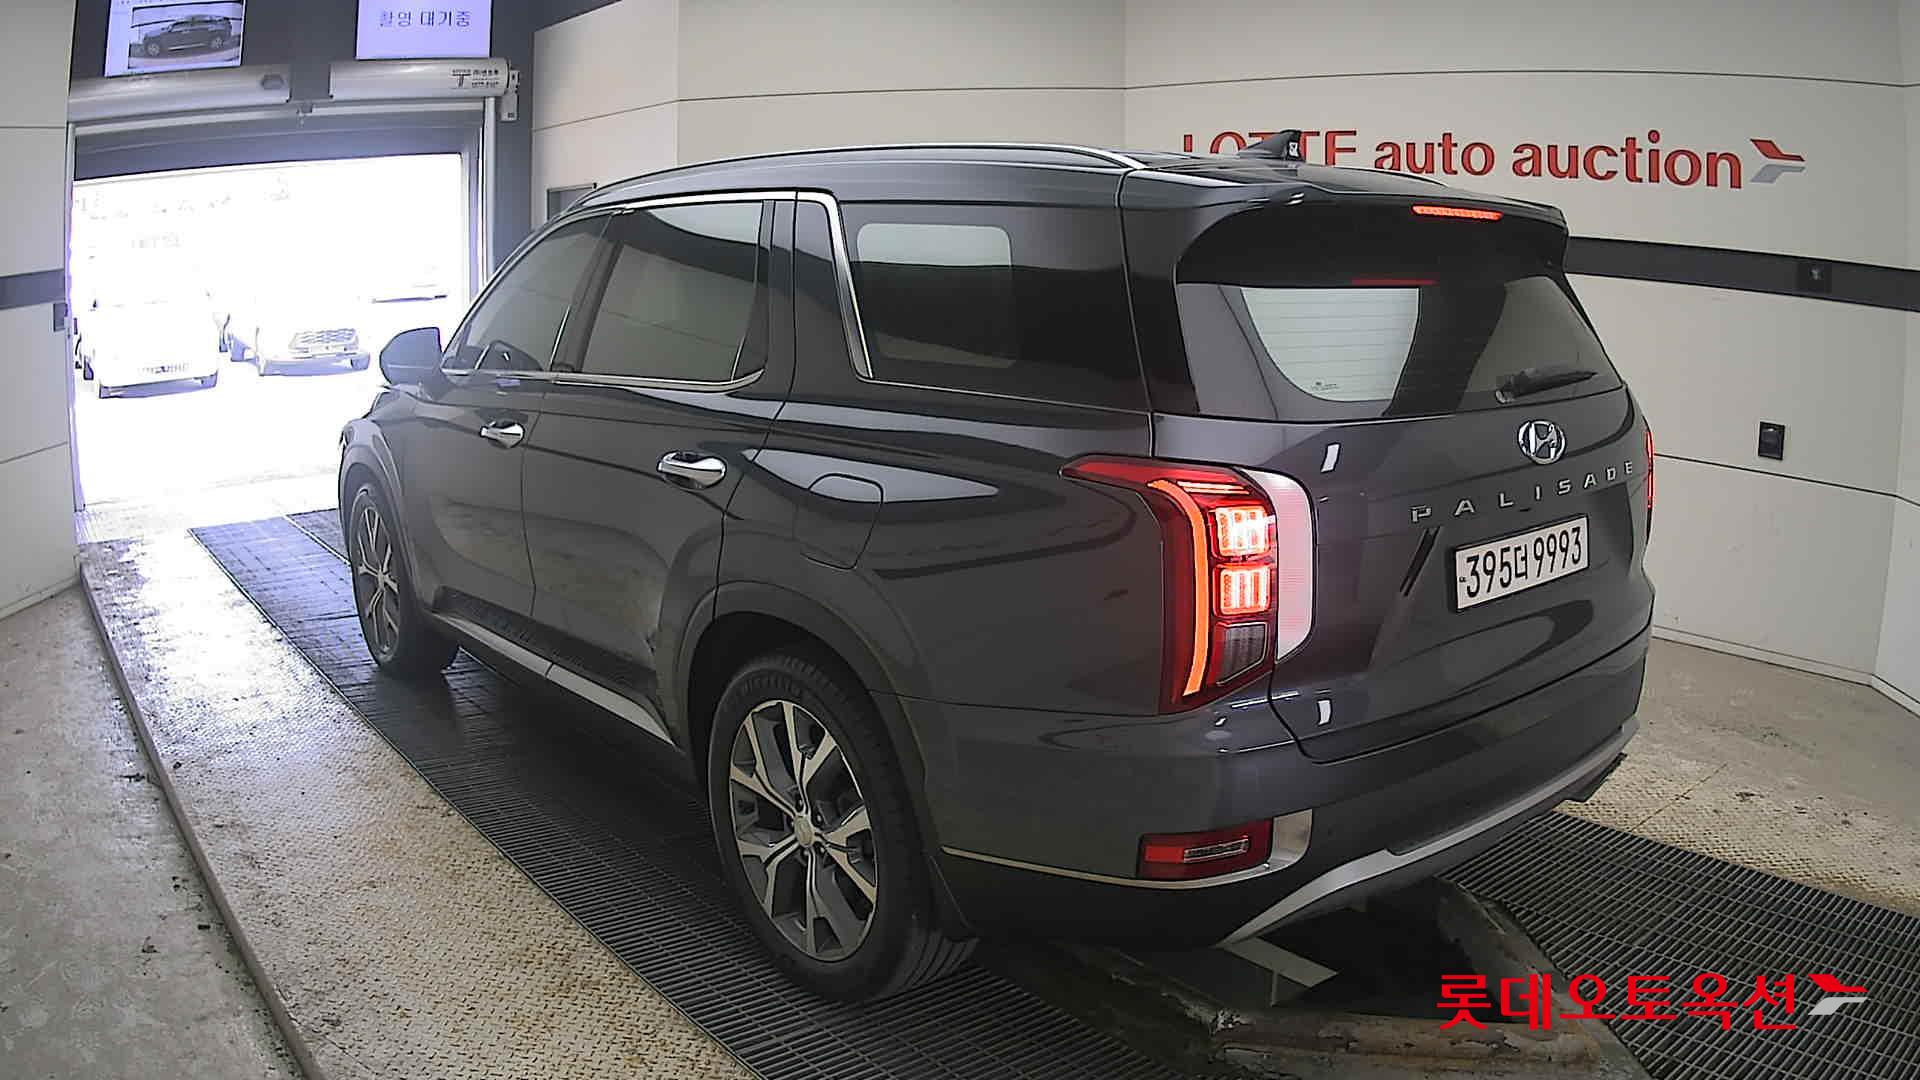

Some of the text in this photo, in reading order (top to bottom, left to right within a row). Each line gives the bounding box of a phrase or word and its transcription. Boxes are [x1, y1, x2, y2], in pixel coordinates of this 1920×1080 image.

[420, 10, 472, 27] 대기중
[1374, 132, 1495, 176] auto
[1511, 129, 1743, 189] auction
[1409, 459, 1635, 523] PALISADE
[1465, 526, 1582, 598] 395더 9993
